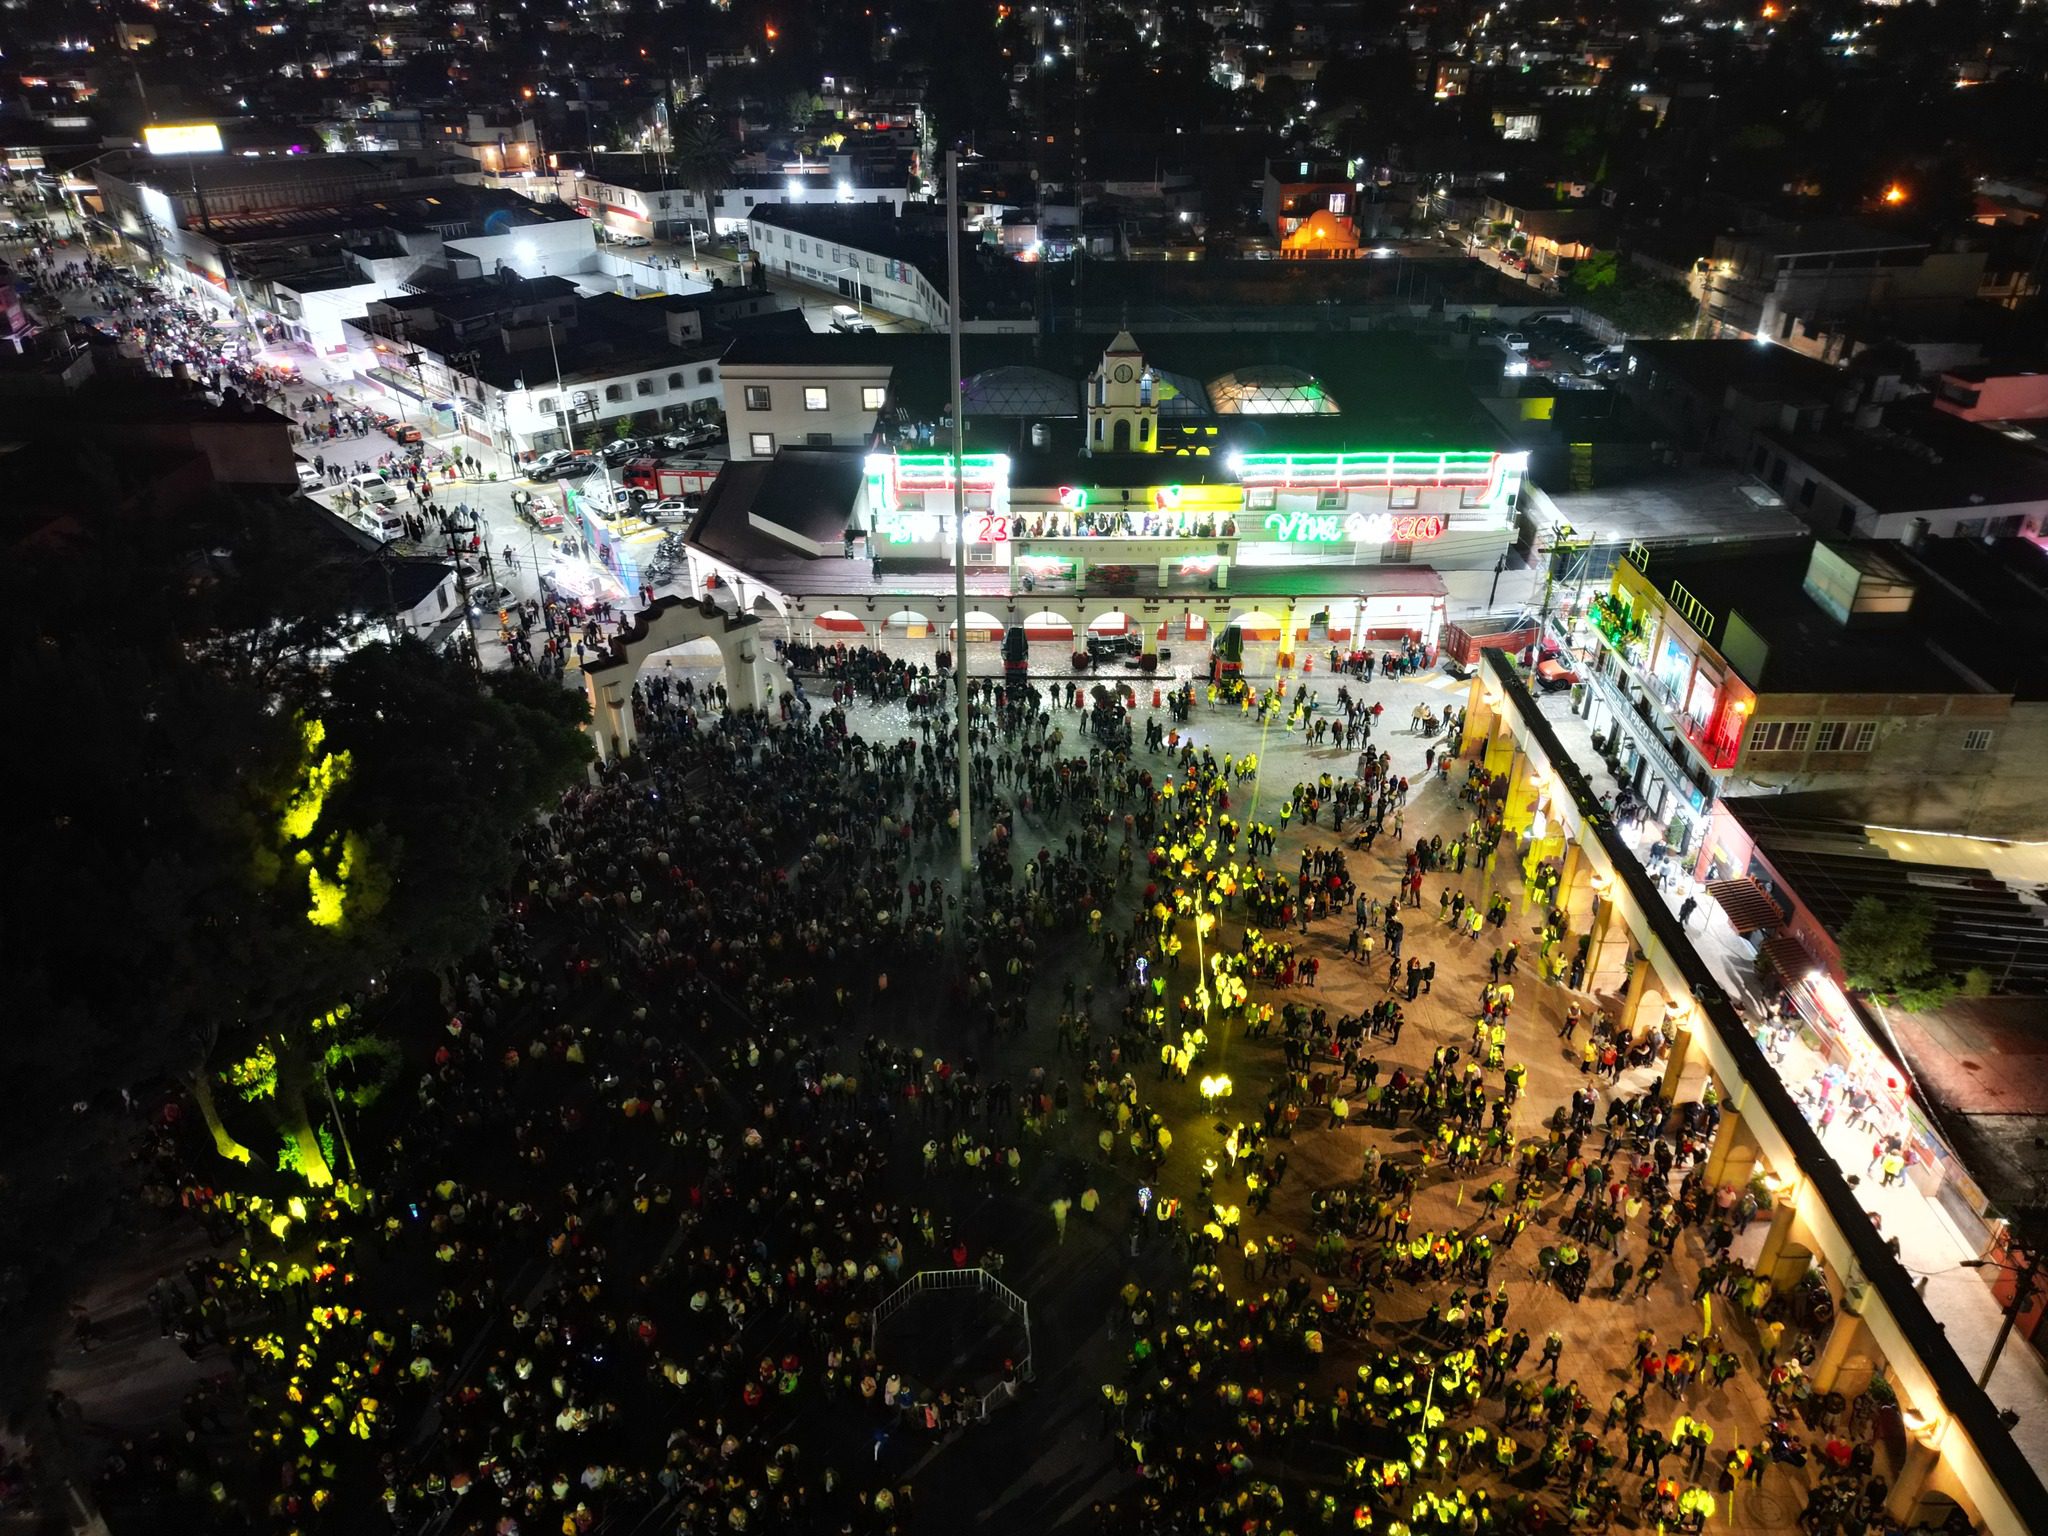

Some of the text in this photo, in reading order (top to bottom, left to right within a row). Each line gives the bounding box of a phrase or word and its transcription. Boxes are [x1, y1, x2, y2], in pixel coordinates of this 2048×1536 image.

[1265, 511, 1342, 541] Viva
[1630, 709, 1679, 778] PACO SANTOS
